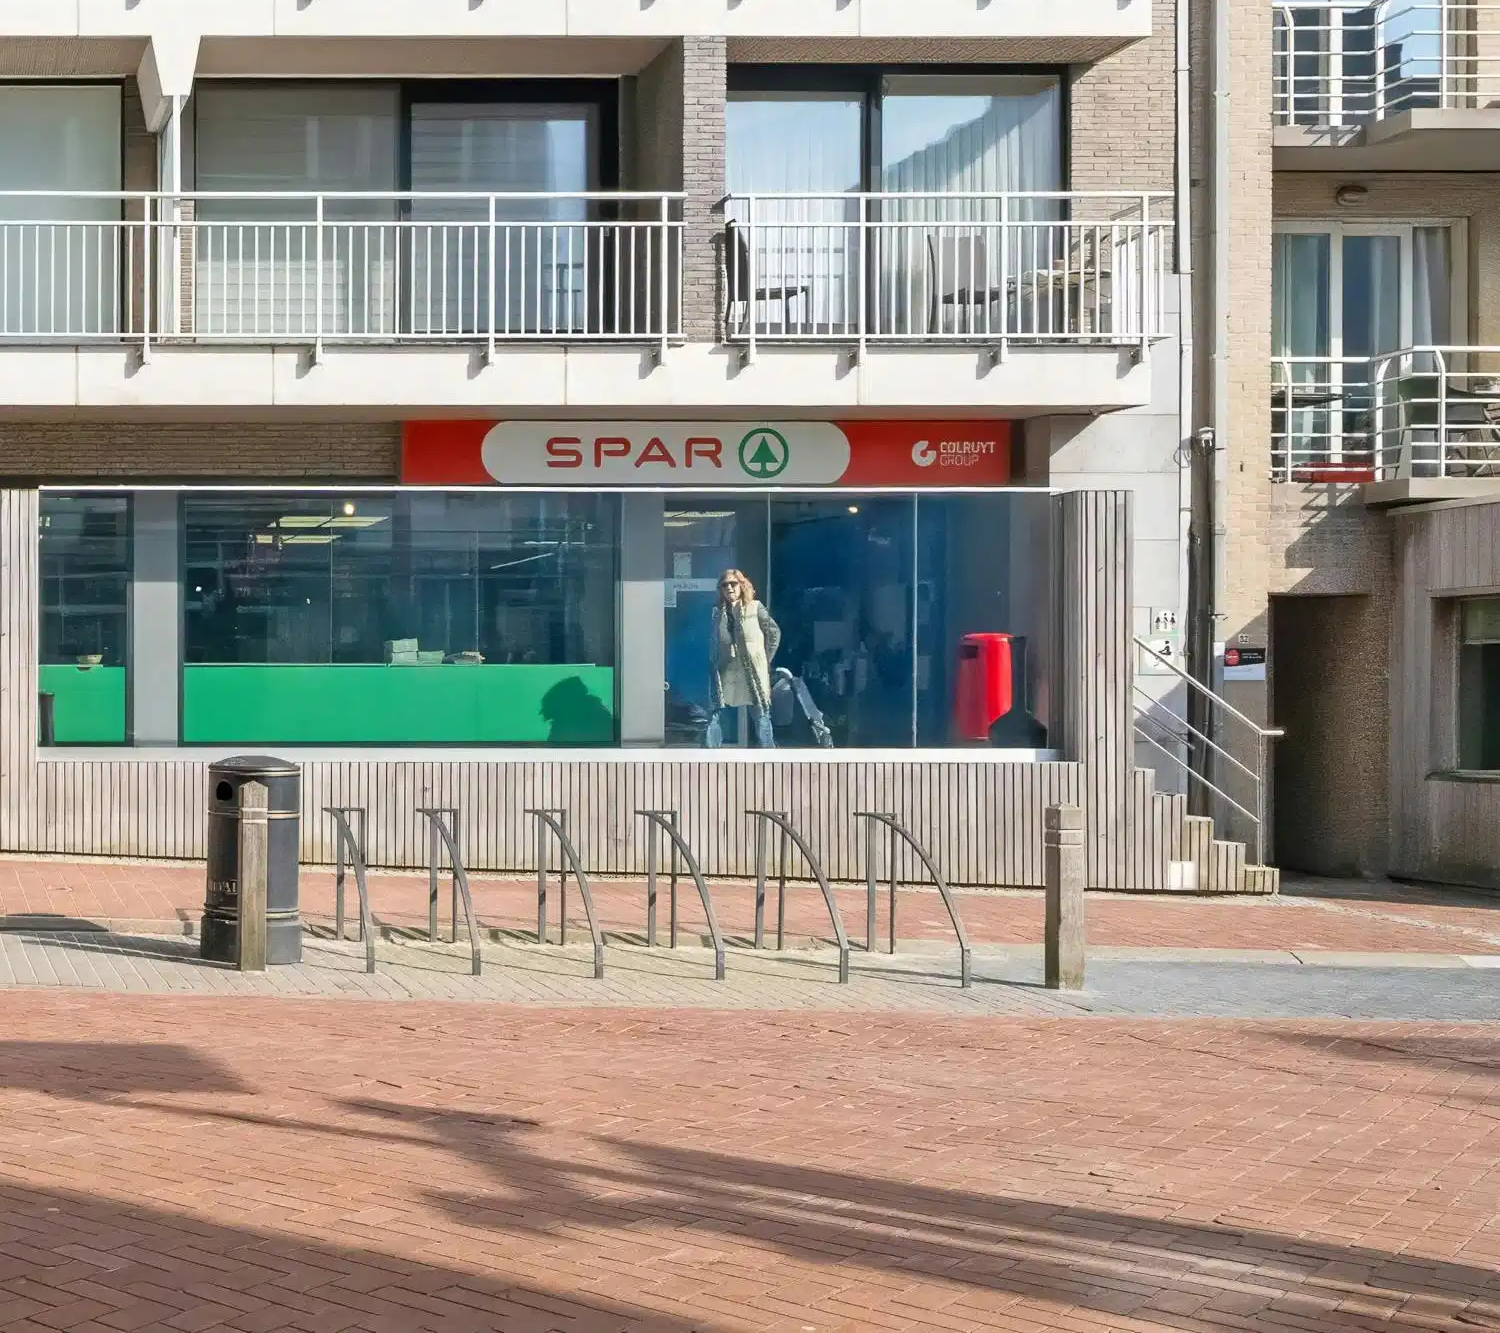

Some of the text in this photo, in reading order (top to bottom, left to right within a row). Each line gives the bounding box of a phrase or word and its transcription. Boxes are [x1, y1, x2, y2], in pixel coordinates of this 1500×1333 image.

[546, 437, 723, 468] SPAR
[940, 441, 996, 454] COLRUYT
[940, 454, 980, 466] GROUP
